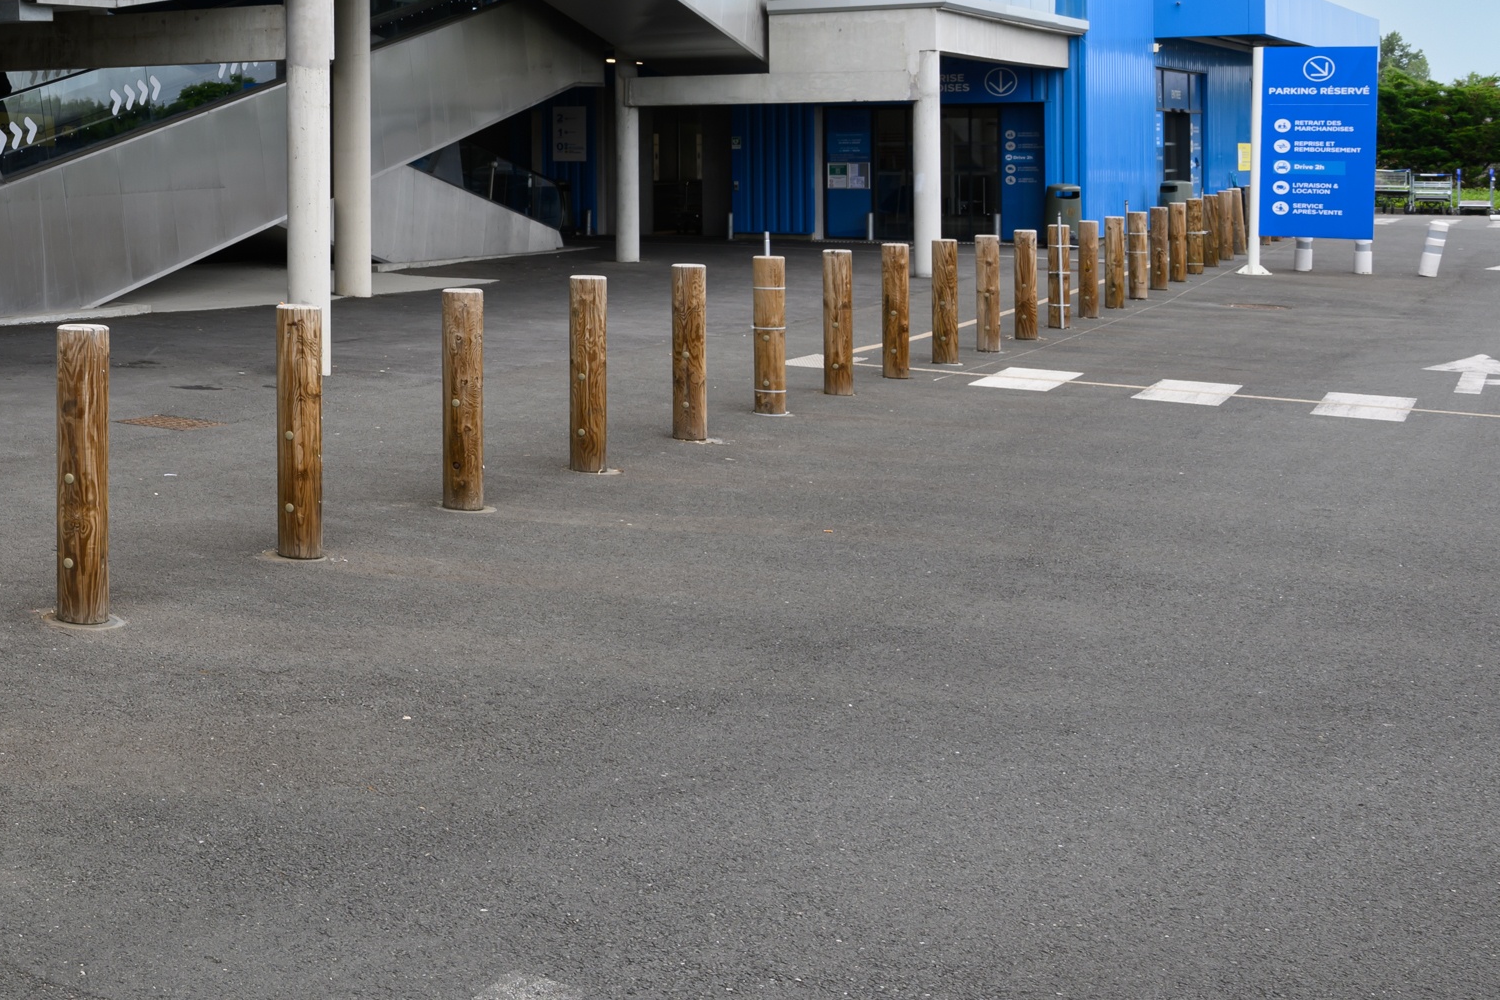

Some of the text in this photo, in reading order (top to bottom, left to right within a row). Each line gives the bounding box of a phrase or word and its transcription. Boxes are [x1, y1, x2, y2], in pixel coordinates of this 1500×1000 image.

[1268, 85, 1370, 95] PARKING RÉSERVÉ
[1292, 208, 1343, 216] APRÈS-VENTE
